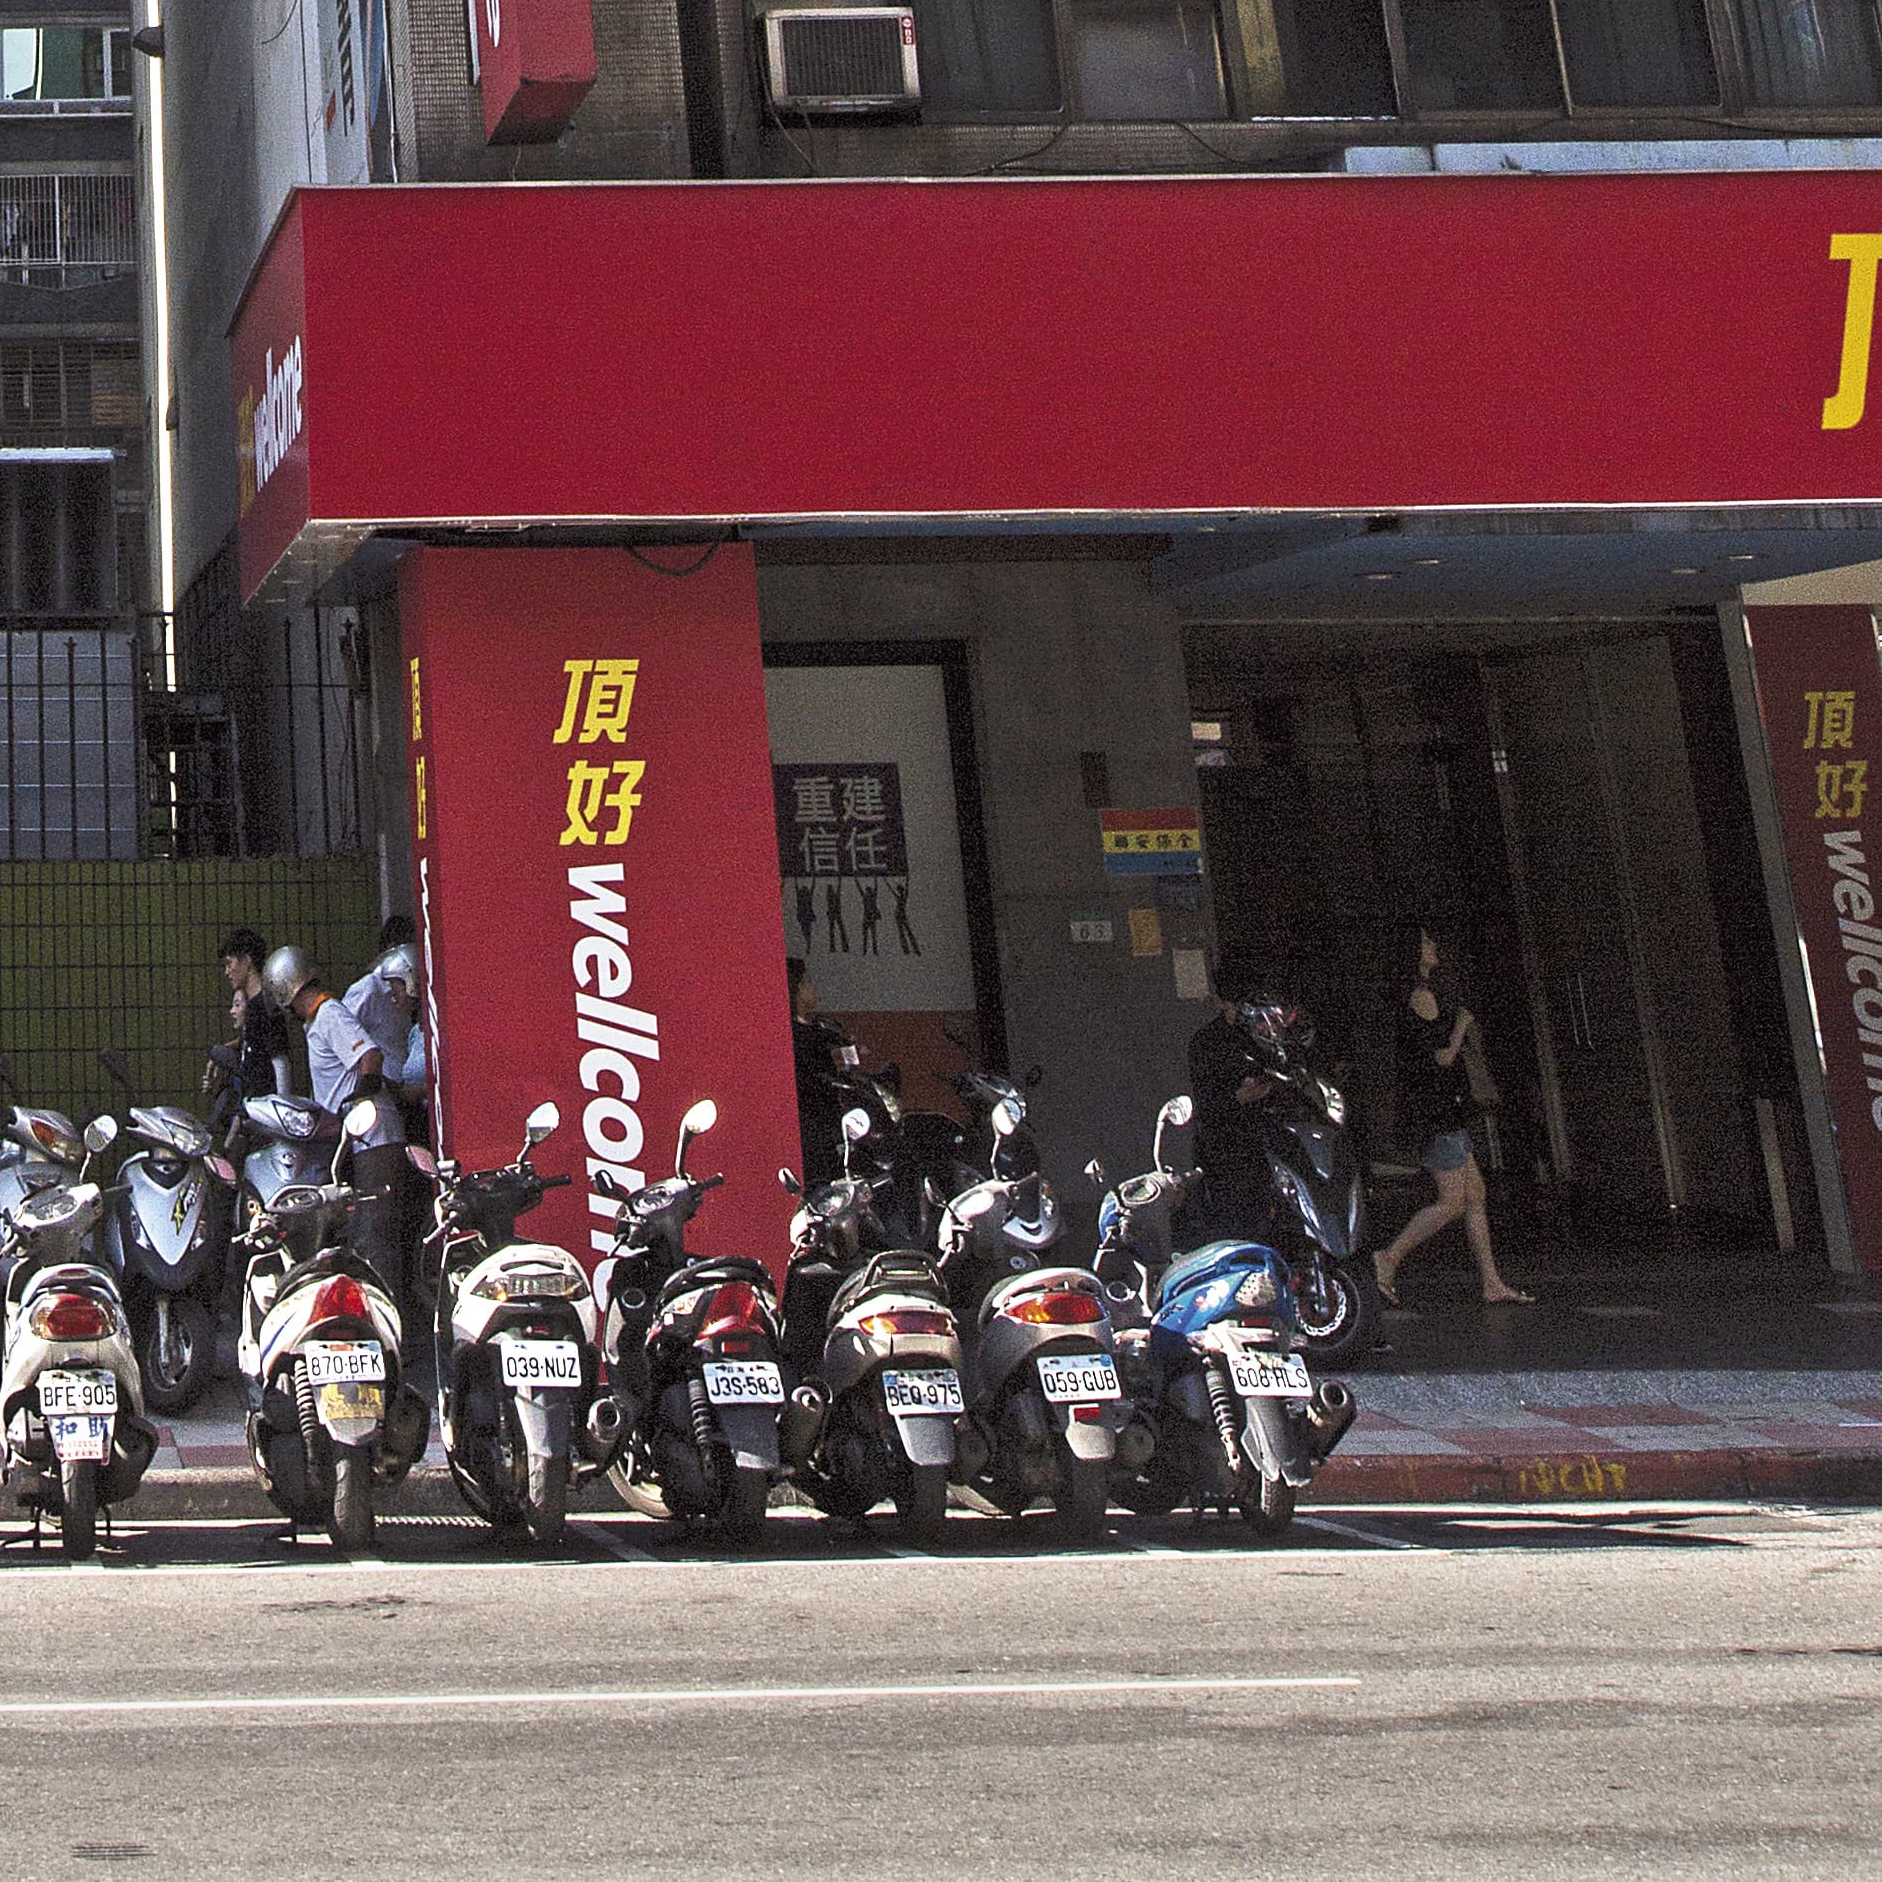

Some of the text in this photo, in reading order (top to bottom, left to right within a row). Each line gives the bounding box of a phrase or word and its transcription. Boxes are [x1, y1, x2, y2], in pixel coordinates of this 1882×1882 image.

[552, 658, 646, 847] 頂好
[1803, 691, 1868, 819] 頂好
[792, 775, 888, 823] 重建
[798, 826, 889, 873] 信任
